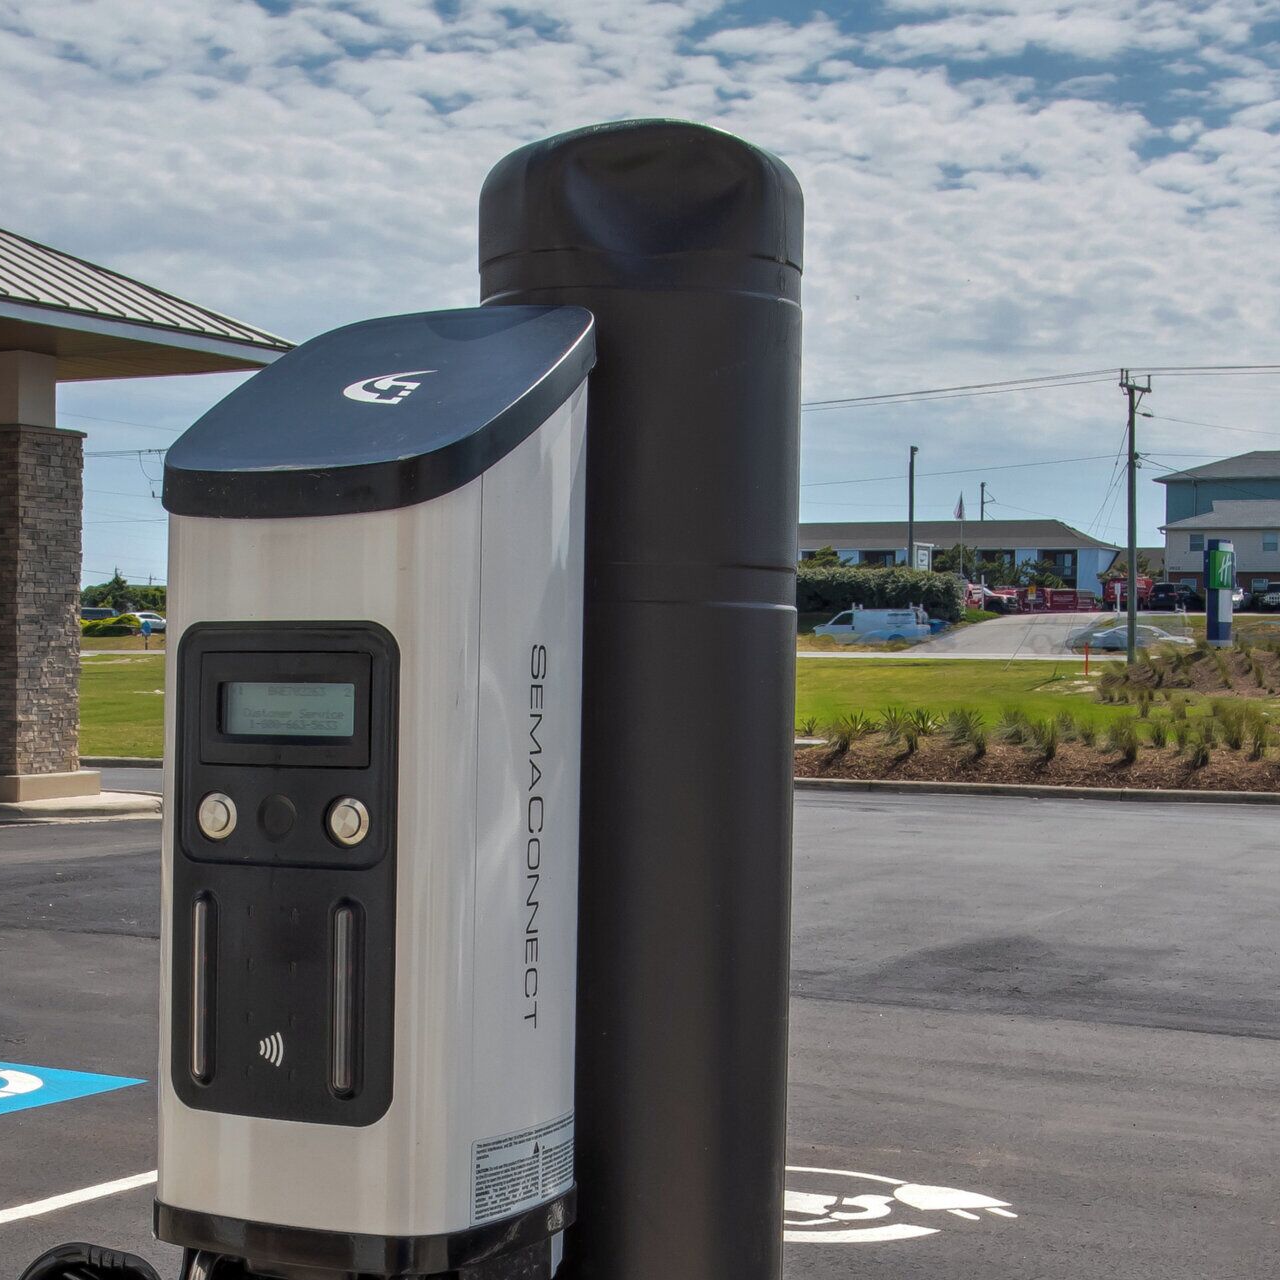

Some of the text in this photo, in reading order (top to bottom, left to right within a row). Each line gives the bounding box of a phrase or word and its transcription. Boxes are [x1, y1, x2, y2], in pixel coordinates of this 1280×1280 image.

[343, 688, 352, 698] 2
[243, 708, 345, 720] Customer Service
[524, 644, 547, 1029] SEMACONNECT
